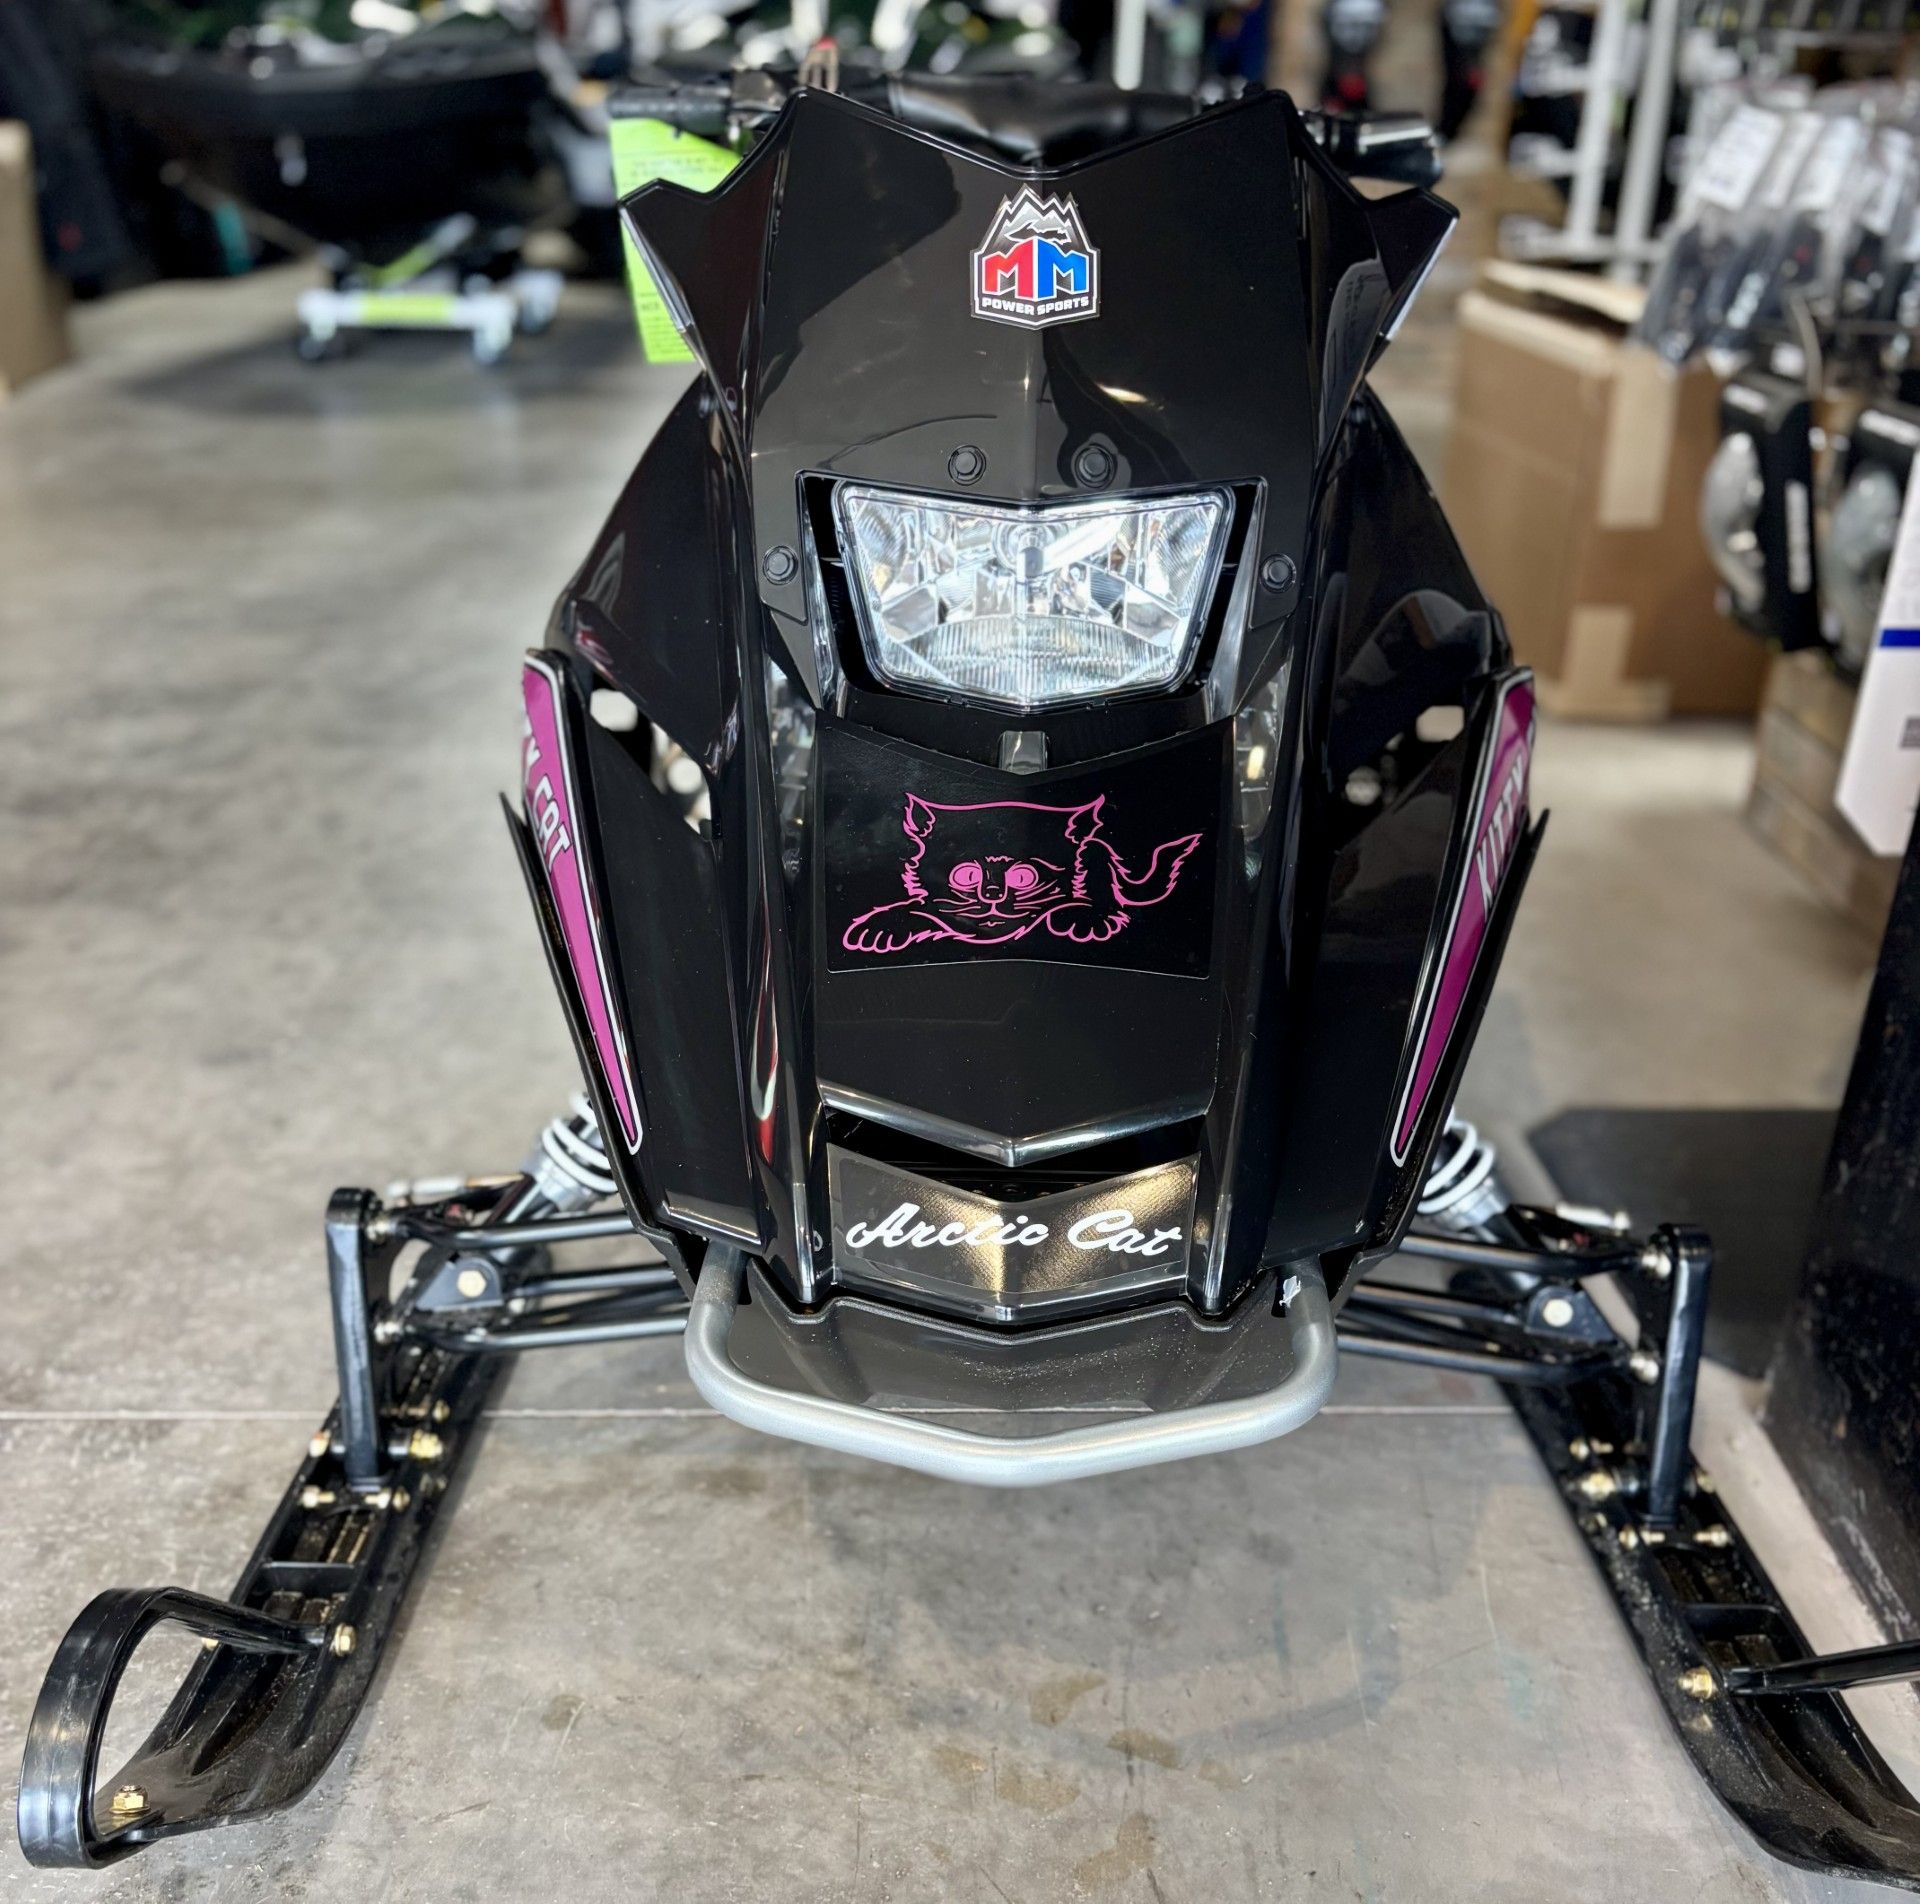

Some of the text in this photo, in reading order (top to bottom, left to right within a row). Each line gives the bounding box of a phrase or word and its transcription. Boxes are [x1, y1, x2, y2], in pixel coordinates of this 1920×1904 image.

[982, 236, 1089, 301] MM
[982, 296, 1089, 315] POWER SPORTS
[533, 774, 571, 872] CAT
[845, 1202, 1182, 1256] Arctic Cat
